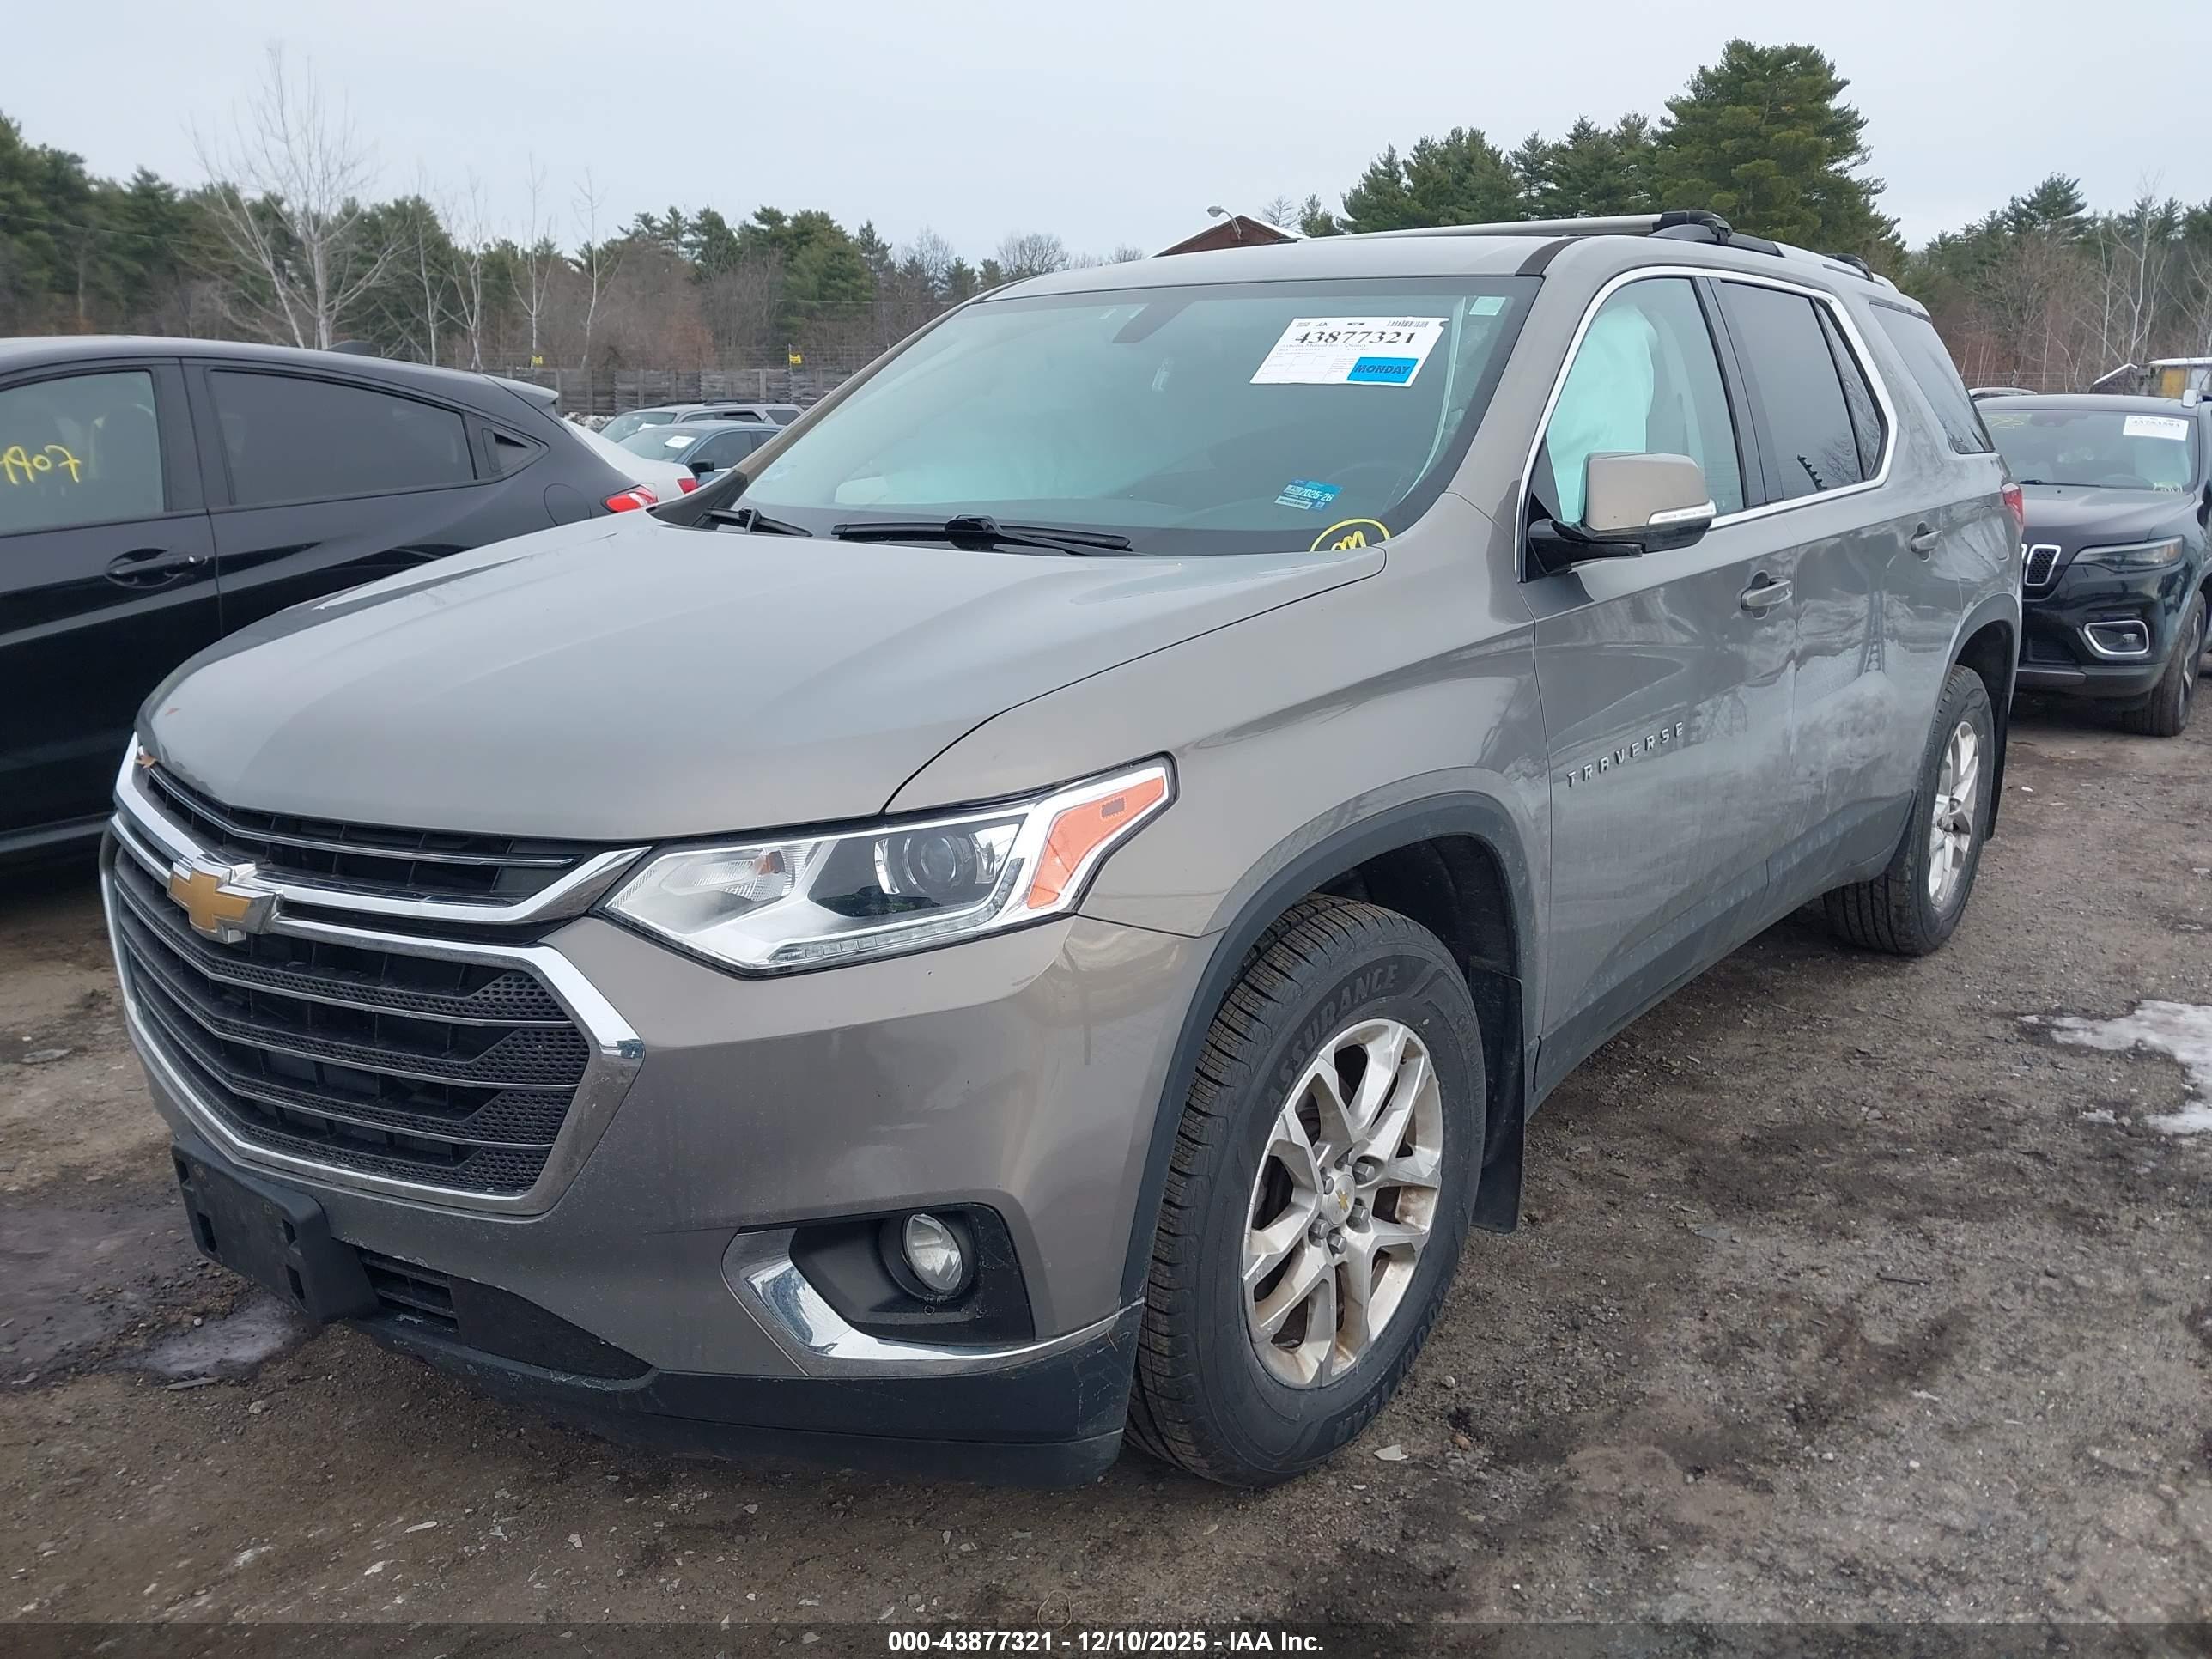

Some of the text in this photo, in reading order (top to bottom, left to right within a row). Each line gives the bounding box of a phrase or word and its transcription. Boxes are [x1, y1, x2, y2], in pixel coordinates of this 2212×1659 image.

[1294, 331, 1417, 344] 43877321
[1353, 364, 1411, 375] MONDAY
[1298, 488, 1335, 502] 2025-26
[1566, 721, 1684, 788] TRAVERSE
[1268, 964, 1398, 1115] ASSURANCE
